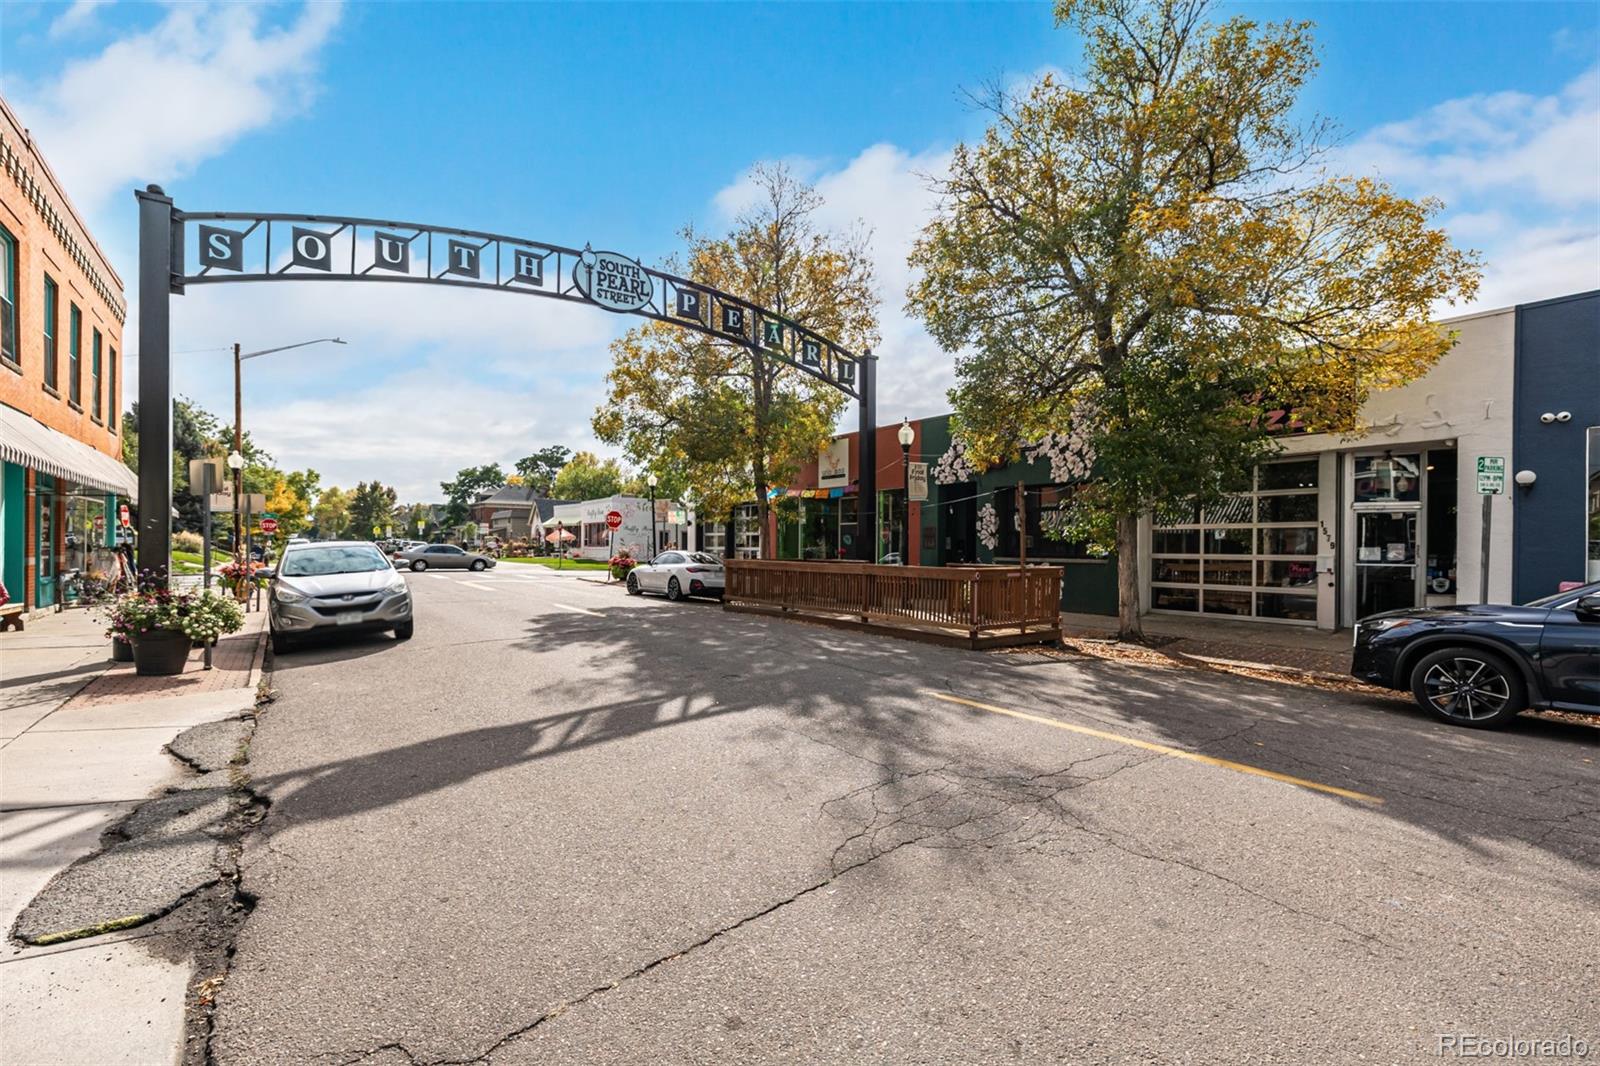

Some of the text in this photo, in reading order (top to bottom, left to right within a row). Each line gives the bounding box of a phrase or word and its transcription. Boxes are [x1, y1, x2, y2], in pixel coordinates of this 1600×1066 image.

[599, 259, 640, 279] SOUTH
[596, 271, 650, 302] PEARL
[208, 232, 855, 380] SOUTH PEARL
[597, 289, 637, 305] STREET
[607, 515, 621, 524] STOP
